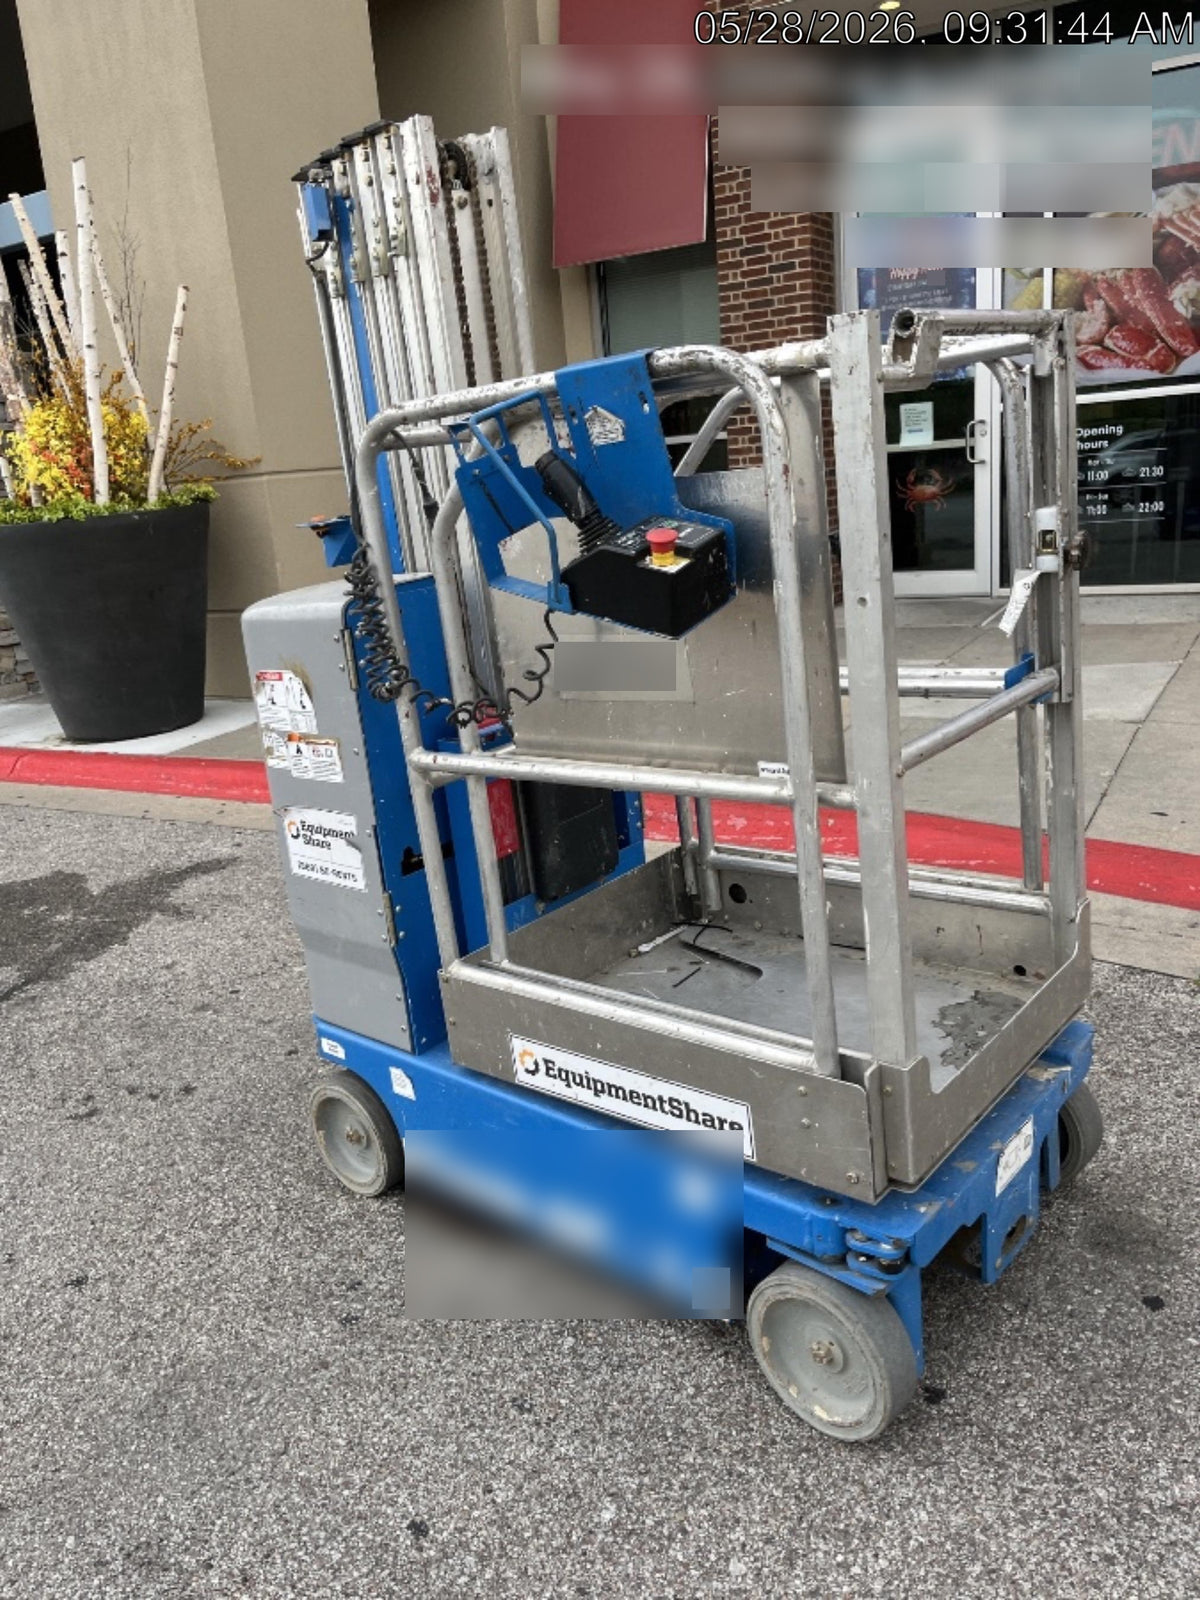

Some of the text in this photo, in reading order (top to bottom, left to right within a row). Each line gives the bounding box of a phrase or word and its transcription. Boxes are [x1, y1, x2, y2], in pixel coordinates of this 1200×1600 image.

[1075, 424, 1123, 438] Opening
[1076, 440, 1109, 451] hours
[302, 833, 332, 851] Share
[541, 1057, 744, 1131] EquipmentShare
